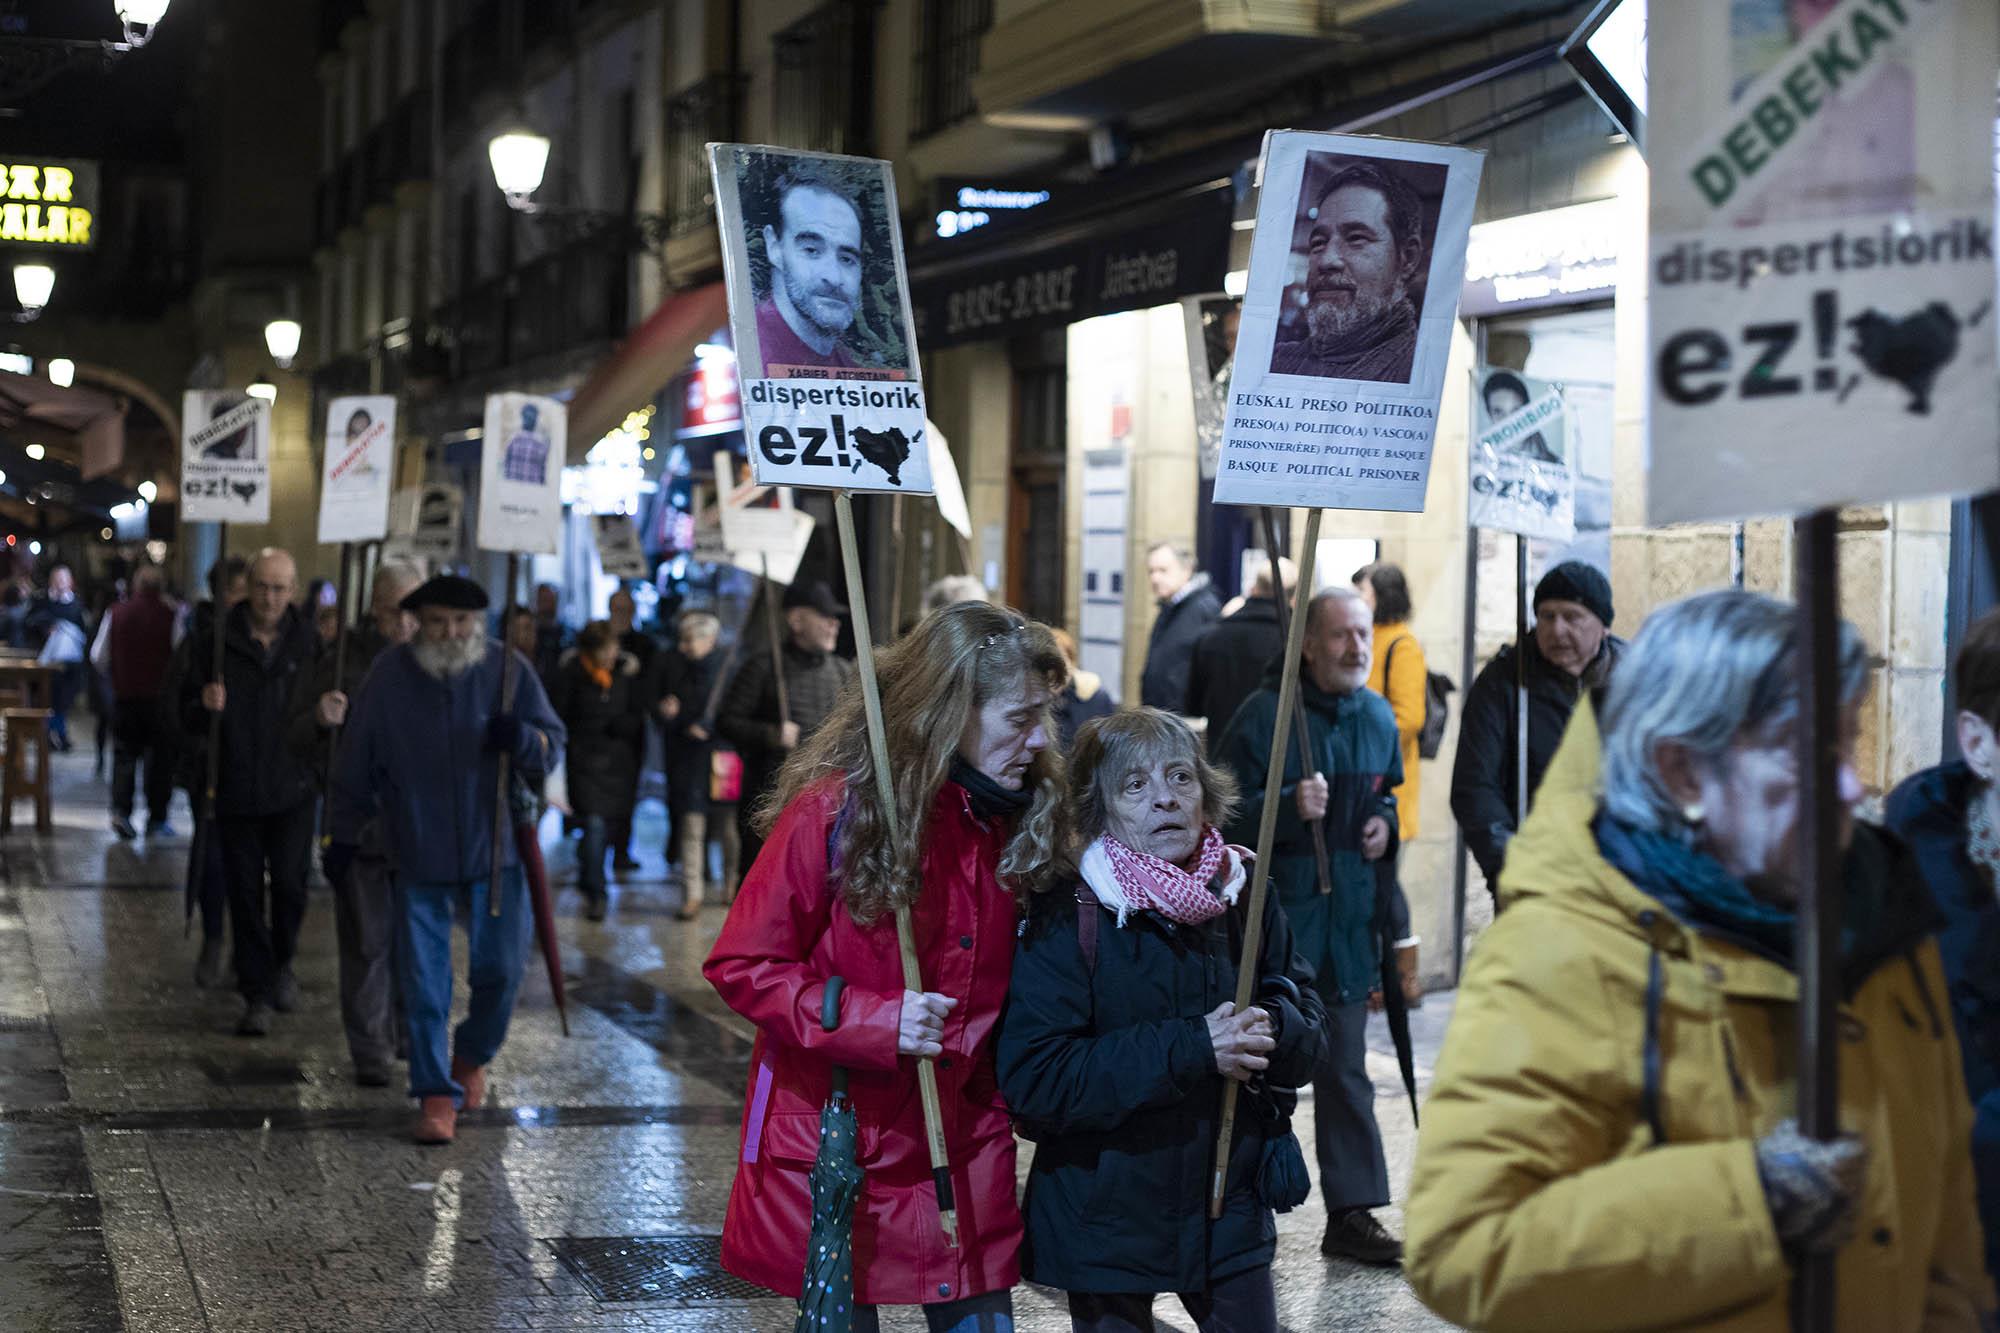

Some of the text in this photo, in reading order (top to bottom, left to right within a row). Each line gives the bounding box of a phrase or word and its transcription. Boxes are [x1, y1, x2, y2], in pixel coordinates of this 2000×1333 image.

[0, 203, 92, 244] ALAR
[1655, 217, 1993, 290] dispertsiorik
[1656, 290, 1838, 407] ez!
[751, 381, 921, 409] dispertsiorik
[1236, 394, 1433, 419] EUSKAL PRESO POLITIKOA
[759, 414, 851, 466] ez!
[1234, 418, 1429, 441] PRESO(A) POLITICO(A) VASCO(A)
[1324, 445, 1380, 458] POLITIQUE
[1384, 449, 1425, 461] BASQUE
[1228, 460, 1420, 482] BASQUE POLITICAL PRISONER
